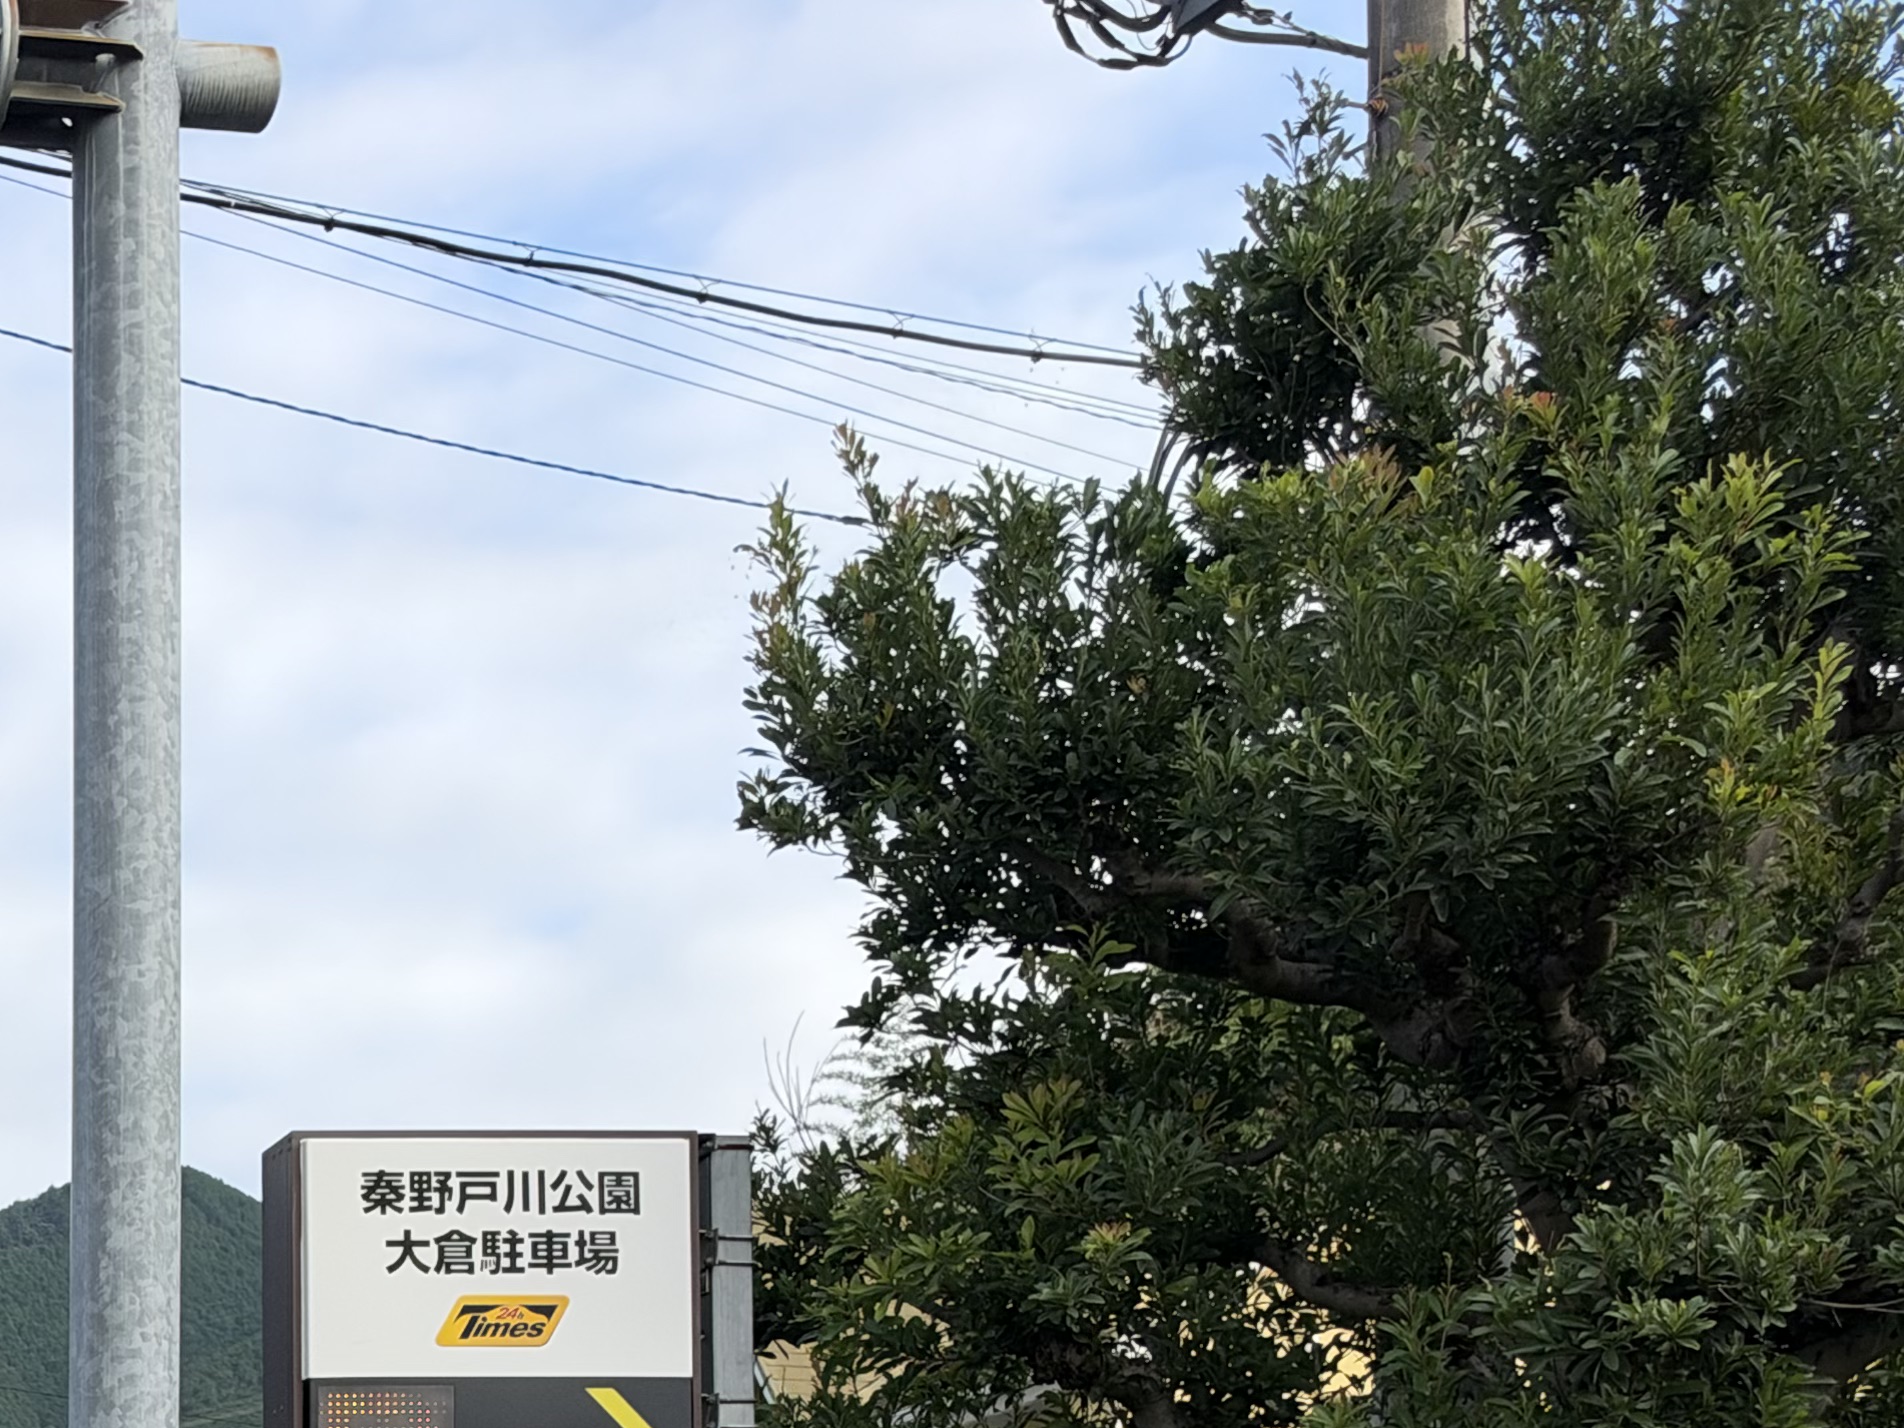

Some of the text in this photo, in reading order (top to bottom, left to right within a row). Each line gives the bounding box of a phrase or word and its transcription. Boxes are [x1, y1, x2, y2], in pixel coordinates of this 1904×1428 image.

[360, 1169, 641, 1216] 秦野戸川公園
[385, 1229, 619, 1276] 大倉駐車場
[459, 1314, 547, 1339] Times
